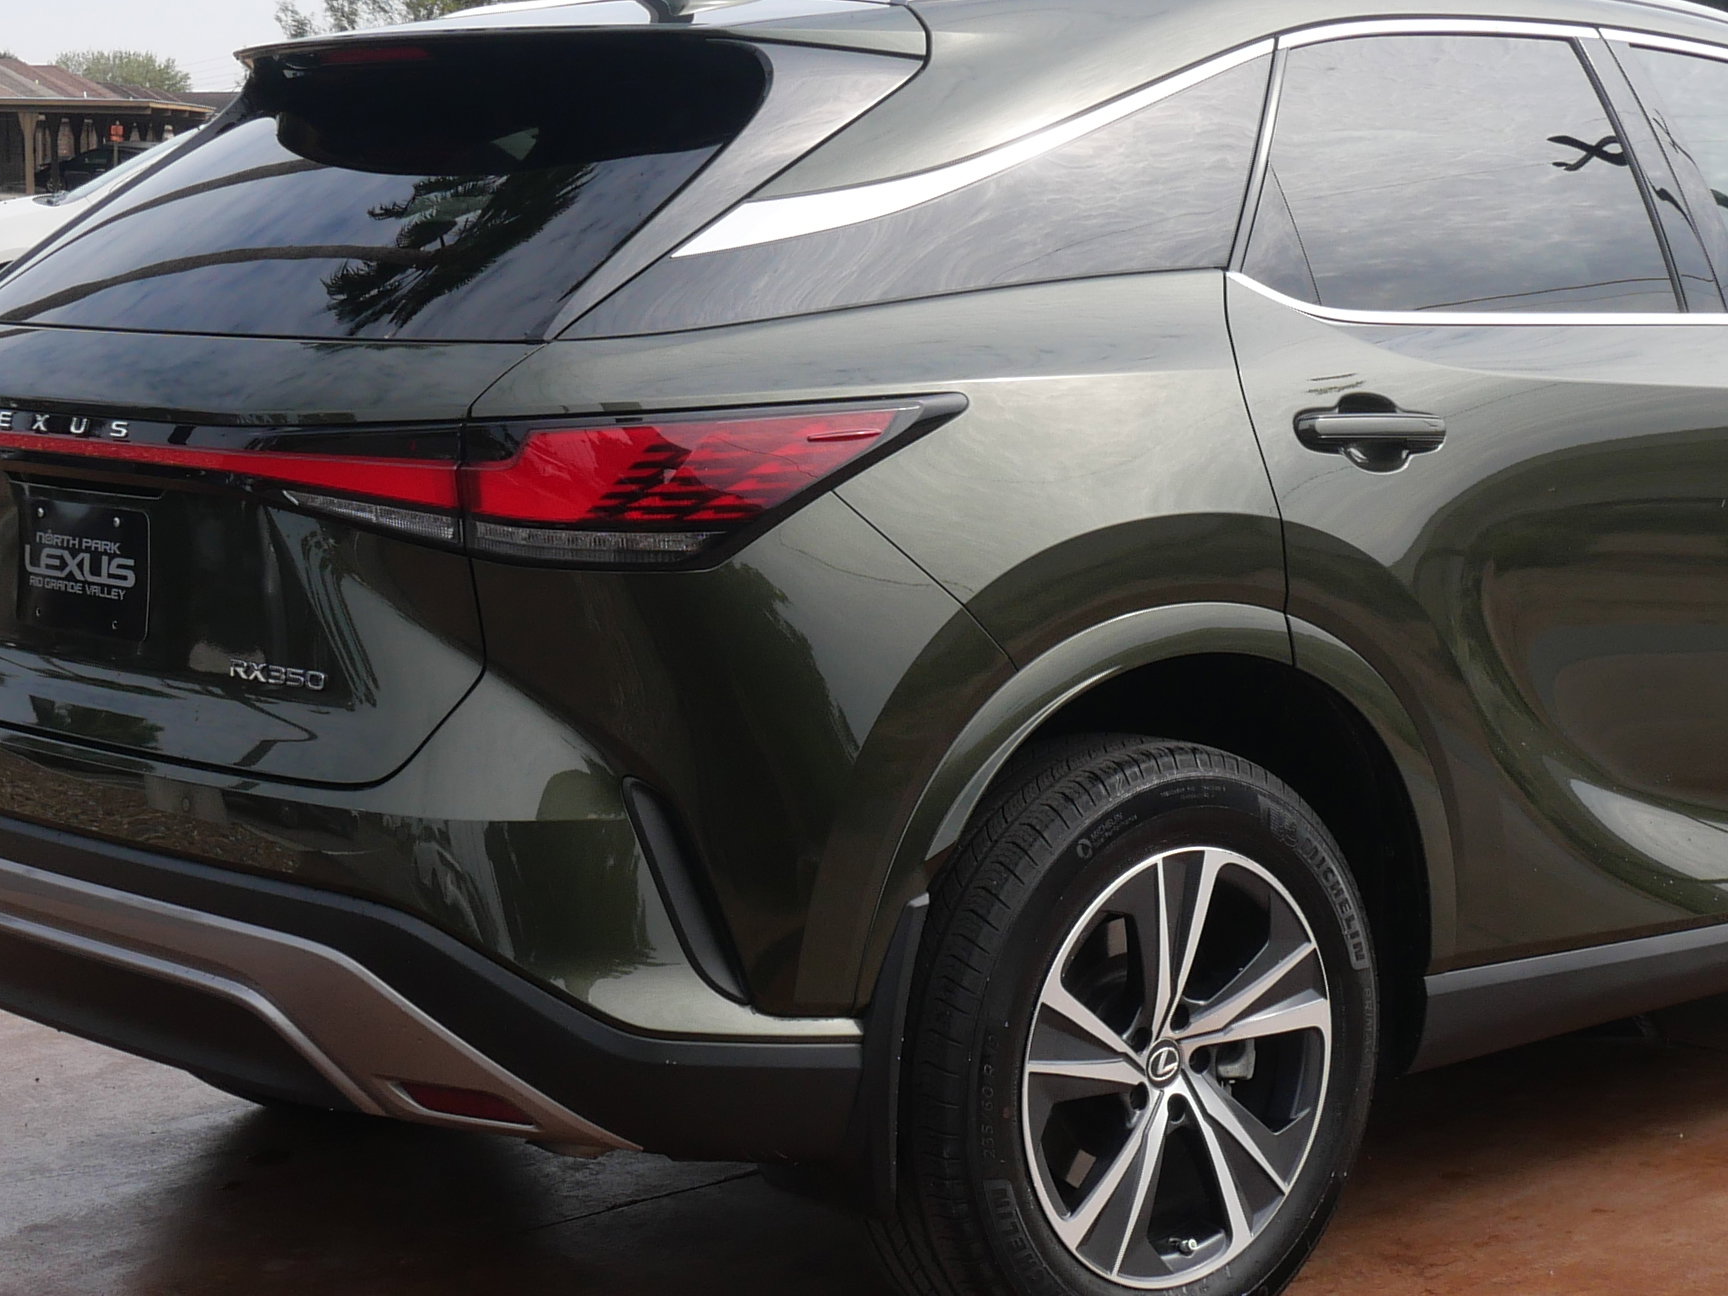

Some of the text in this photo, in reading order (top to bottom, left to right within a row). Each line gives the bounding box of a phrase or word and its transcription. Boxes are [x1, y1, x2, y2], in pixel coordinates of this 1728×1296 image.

[81, 538, 121, 554] PARK
[24, 544, 136, 588] LEXUS
[29, 575, 126, 601] RIO GRANDE VALLEY
[1300, 834, 1368, 963] MICHELIN
